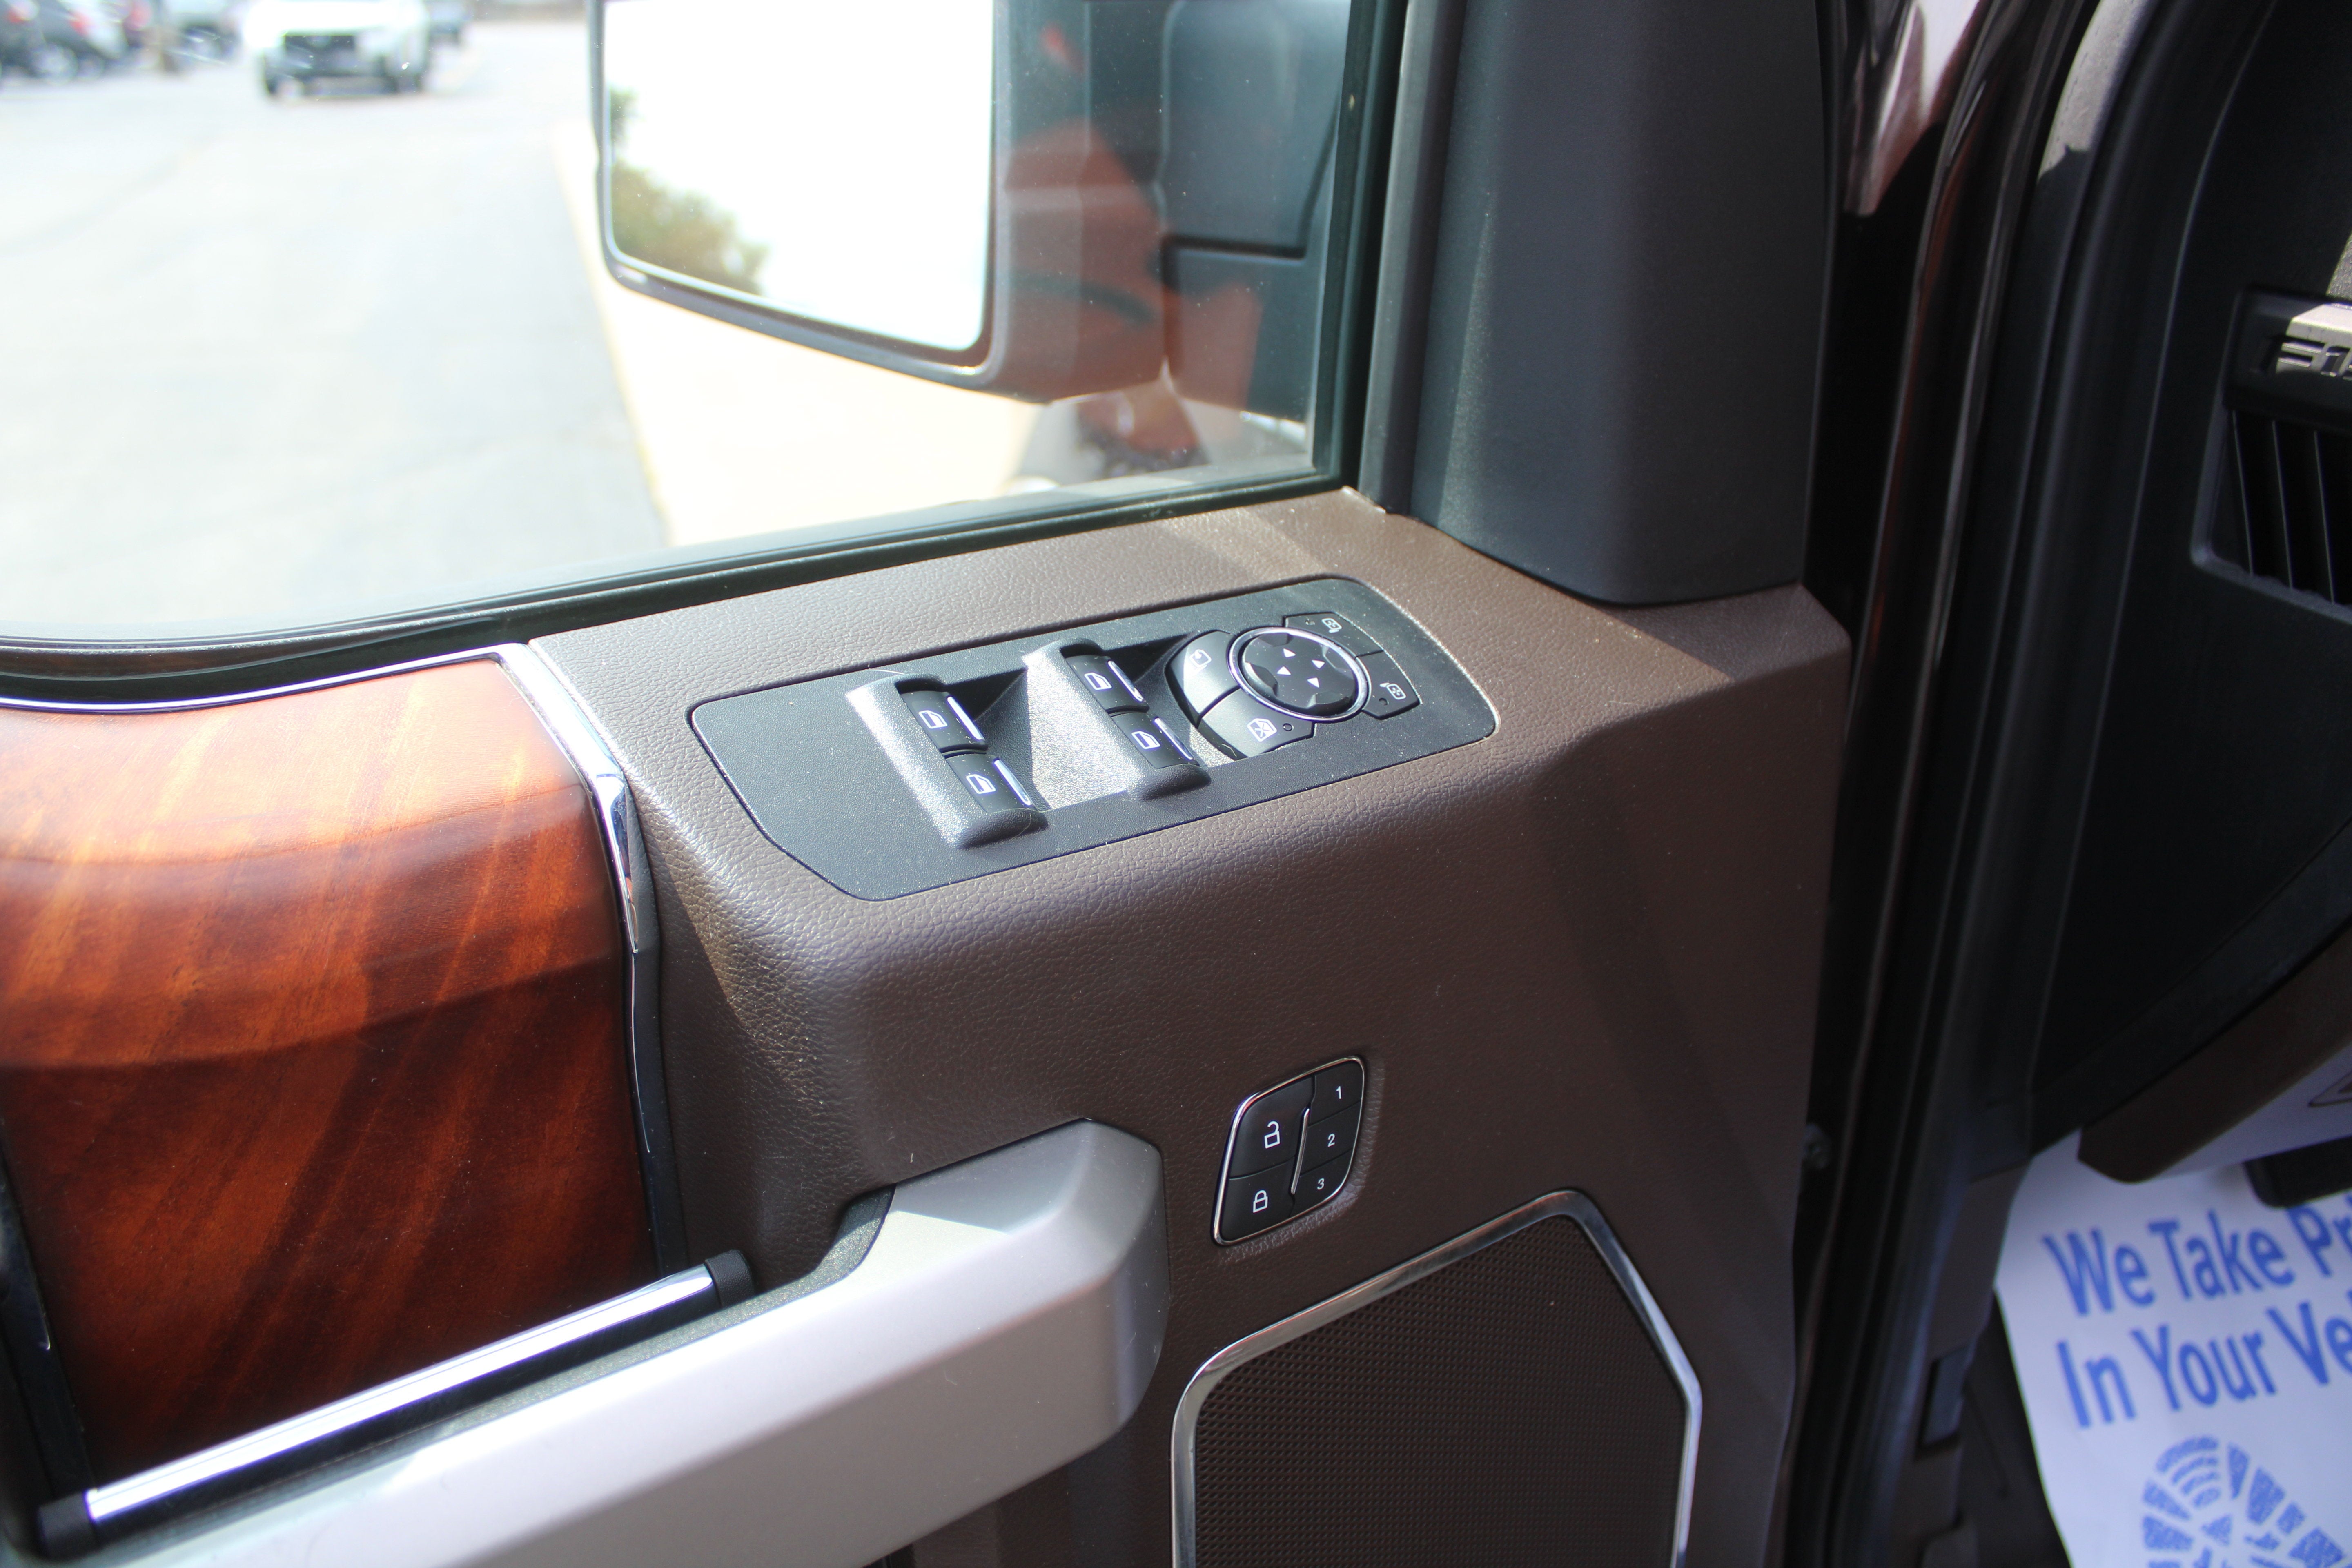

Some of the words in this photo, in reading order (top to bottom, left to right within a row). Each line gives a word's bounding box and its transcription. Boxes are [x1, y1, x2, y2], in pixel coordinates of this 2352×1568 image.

[1336, 1085, 1342, 1100] 1
[1327, 1133, 1336, 1147] 2
[1316, 1178, 1325, 1190] 3
[2043, 1229, 2156, 1317] We
[2148, 1210, 2296, 1300] Take
[2287, 1196, 2352, 1278] Pr
[2056, 1341, 2137, 1429] In
[2131, 1324, 2277, 1412] Your
[2265, 1289, 2352, 1387] Ve
